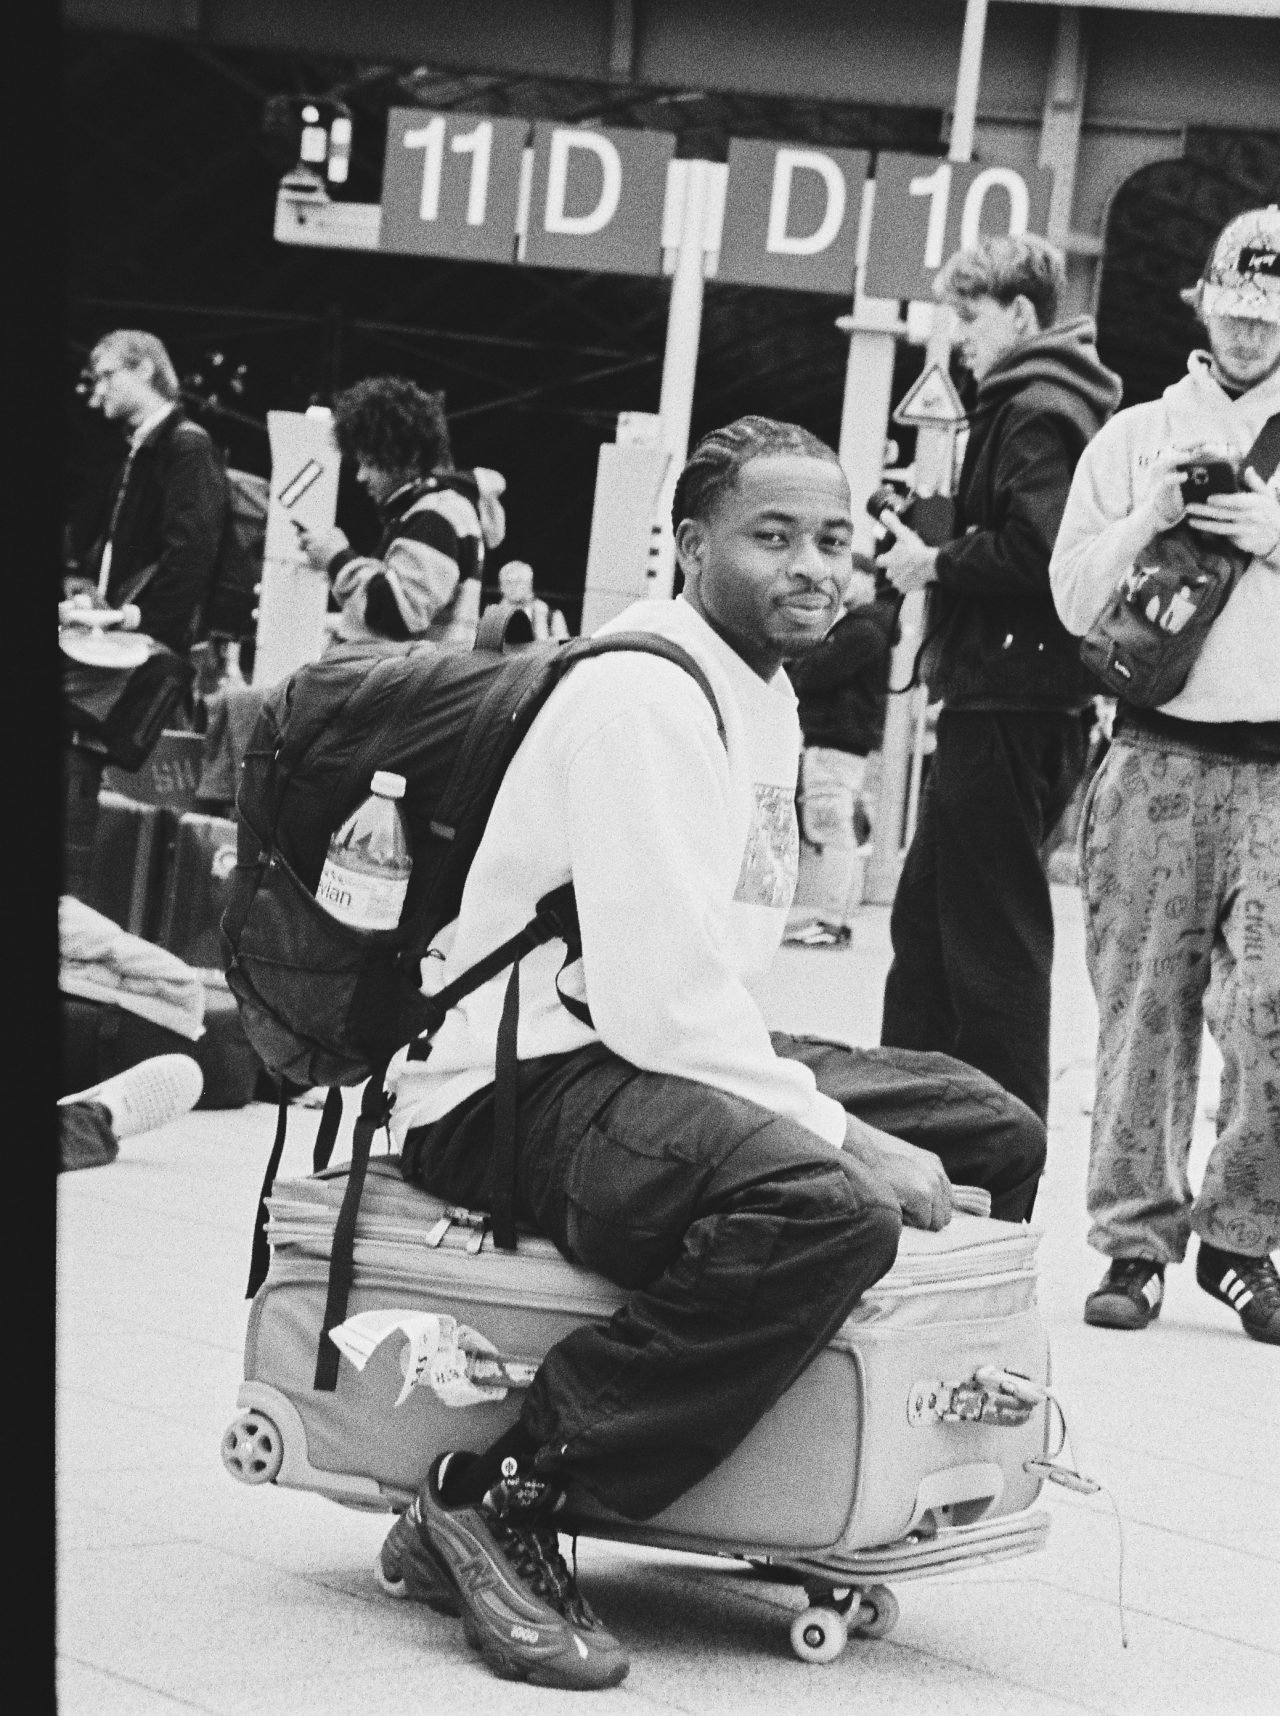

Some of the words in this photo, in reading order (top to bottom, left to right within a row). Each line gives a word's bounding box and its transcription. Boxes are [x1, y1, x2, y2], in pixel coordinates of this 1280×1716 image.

[403, 116, 493, 226] 11
[543, 129, 623, 235] D
[766, 148, 847, 255] D
[908, 163, 1030, 268] 10
[317, 880, 352, 906] vian
